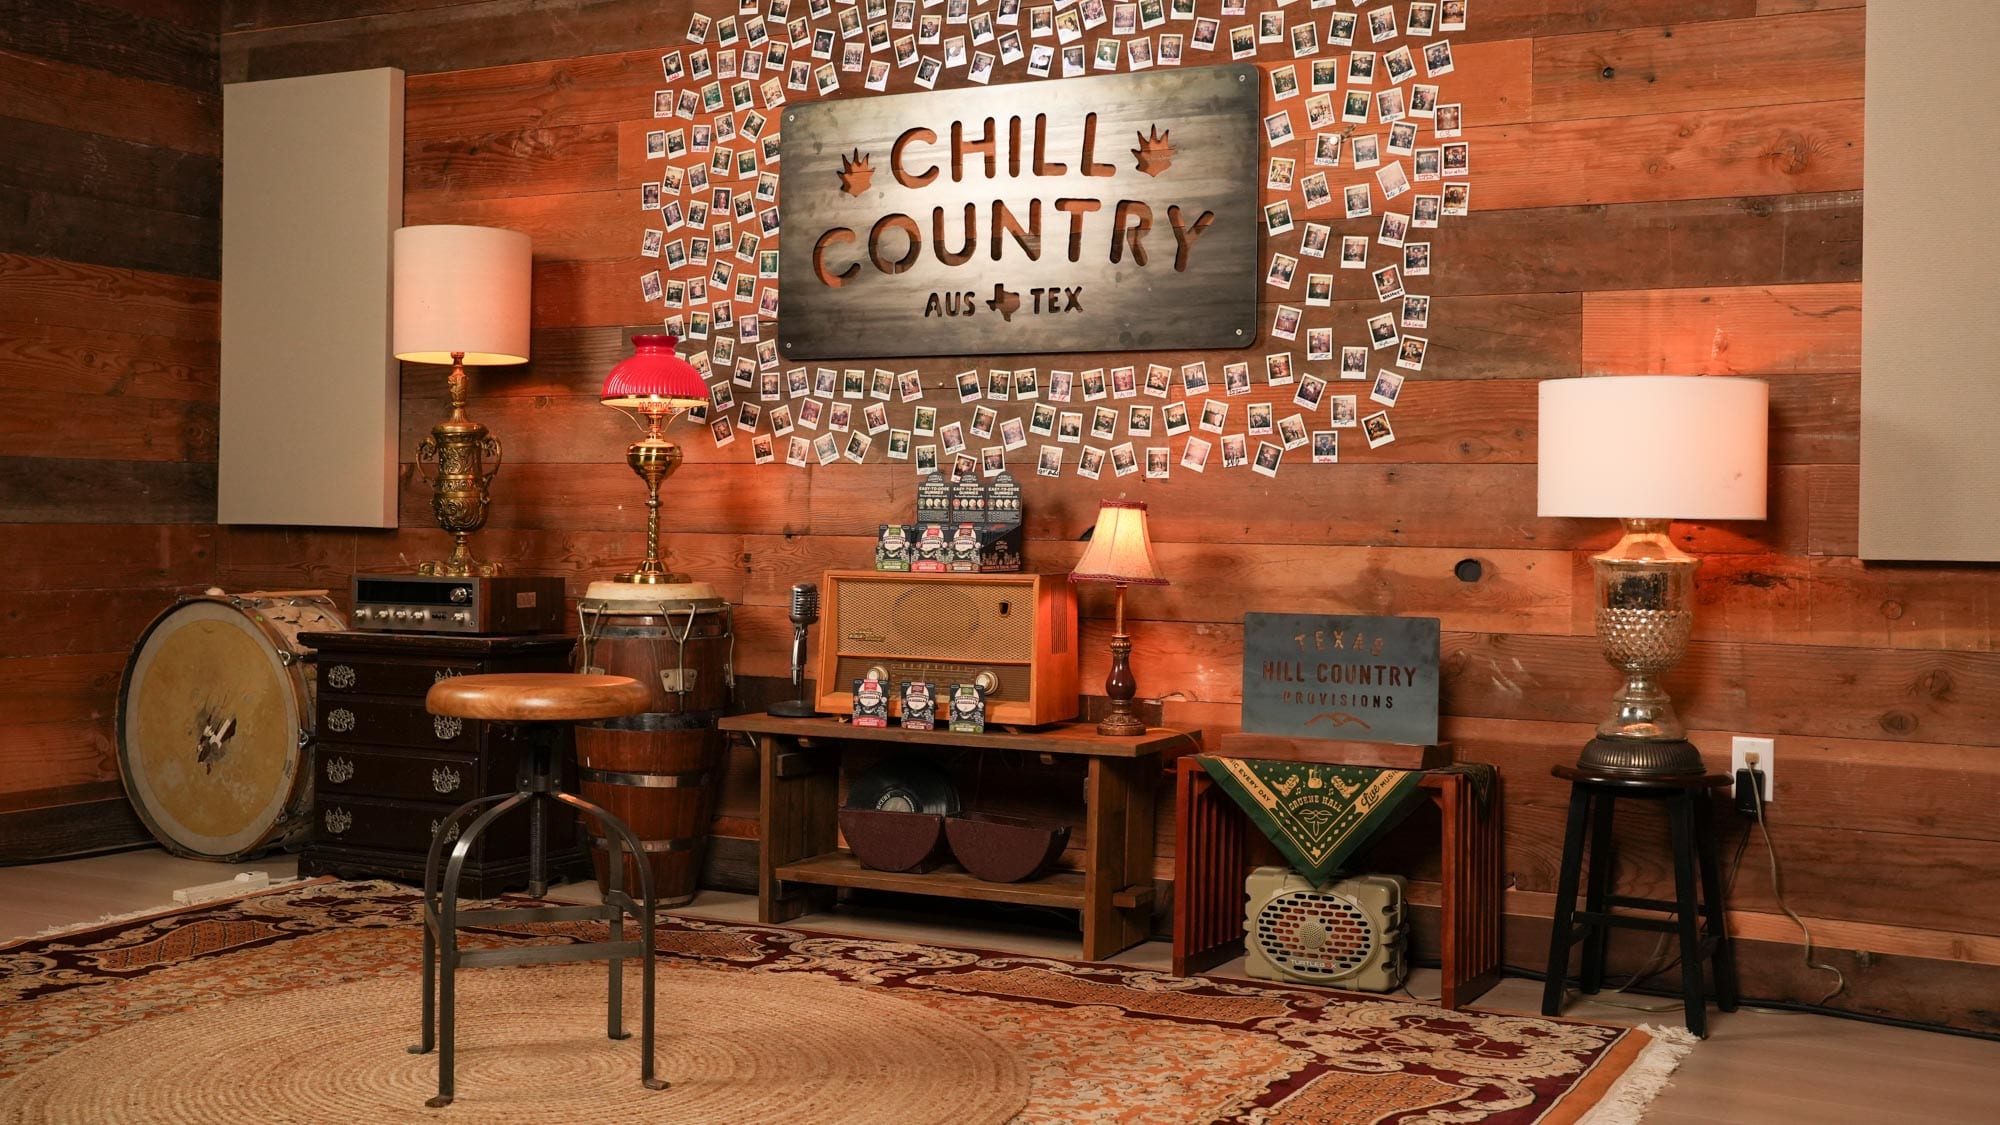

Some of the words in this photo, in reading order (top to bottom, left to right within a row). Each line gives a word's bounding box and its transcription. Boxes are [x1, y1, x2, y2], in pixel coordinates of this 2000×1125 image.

[890, 111, 1117, 189] CHILL
[812, 197, 1215, 288] COUNTRY
[924, 290, 976, 318] AUS
[1030, 285, 1084, 314] TEX
[1294, 630, 1384, 657] TEXAS
[1262, 660, 1305, 683] HILL
[1316, 663, 1418, 688] COUNTRY
[1283, 690, 1394, 709] PROVISIONS
[1238, 768, 1259, 789] EVERY
[1258, 789, 1271, 802] DAY
[1360, 784, 1380, 809] Live
[1288, 794, 1320, 812] GRUENE
[1321, 795, 1343, 813] HALL
